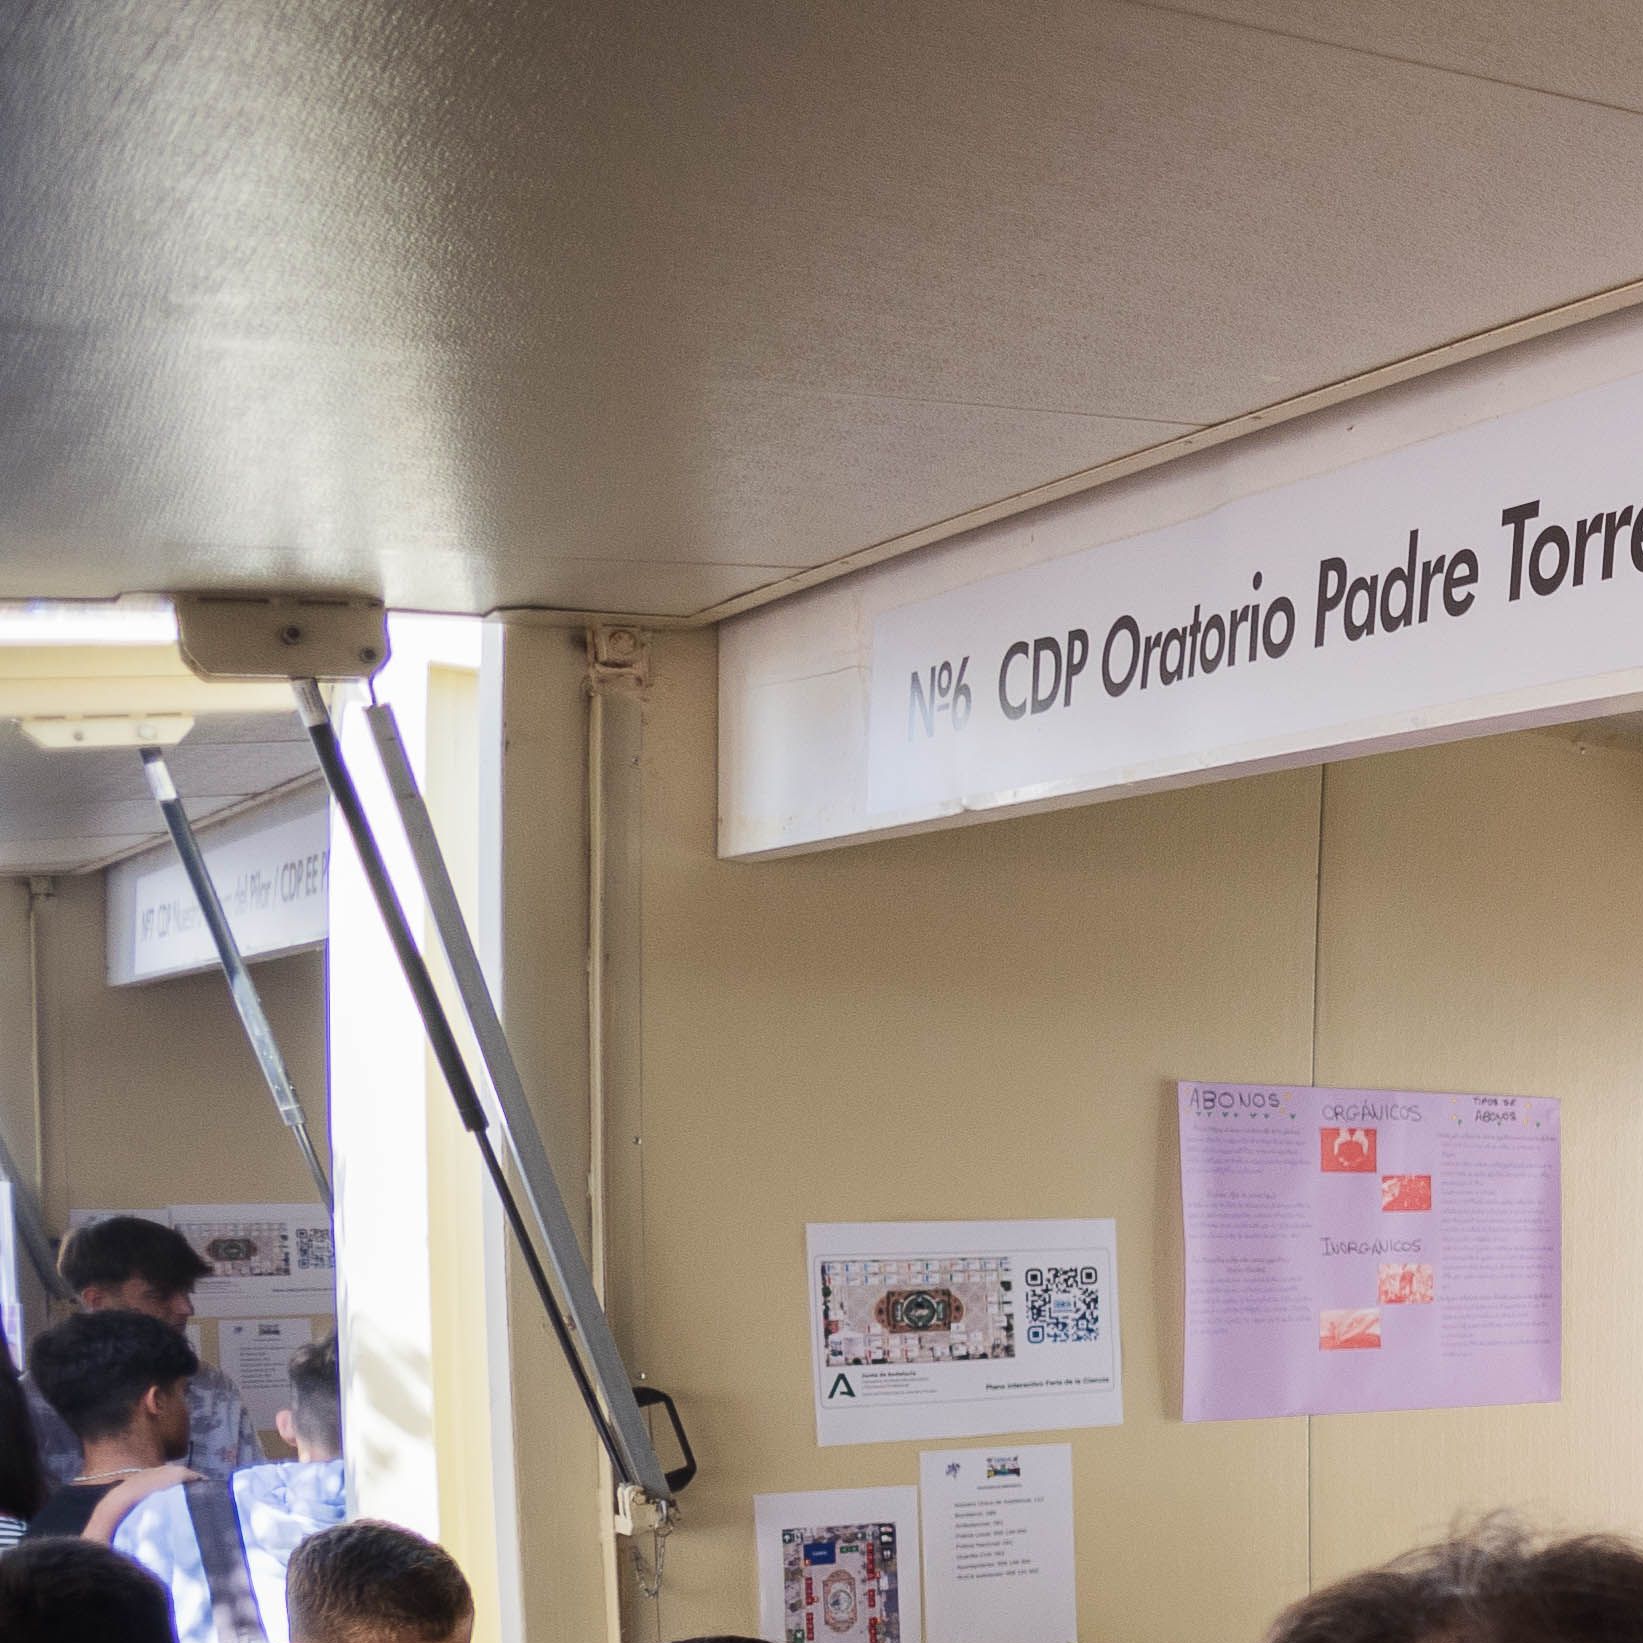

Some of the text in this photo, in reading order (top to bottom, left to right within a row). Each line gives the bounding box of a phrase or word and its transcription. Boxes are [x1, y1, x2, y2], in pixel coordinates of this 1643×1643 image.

[998, 628, 1089, 720] CDP
[1101, 594, 1296, 698] Oratorio
[1314, 528, 1479, 649] Padre
[1190, 1087, 1281, 1111] ABONOS
[1322, 1099, 1423, 1123] ORGÁNICOS
